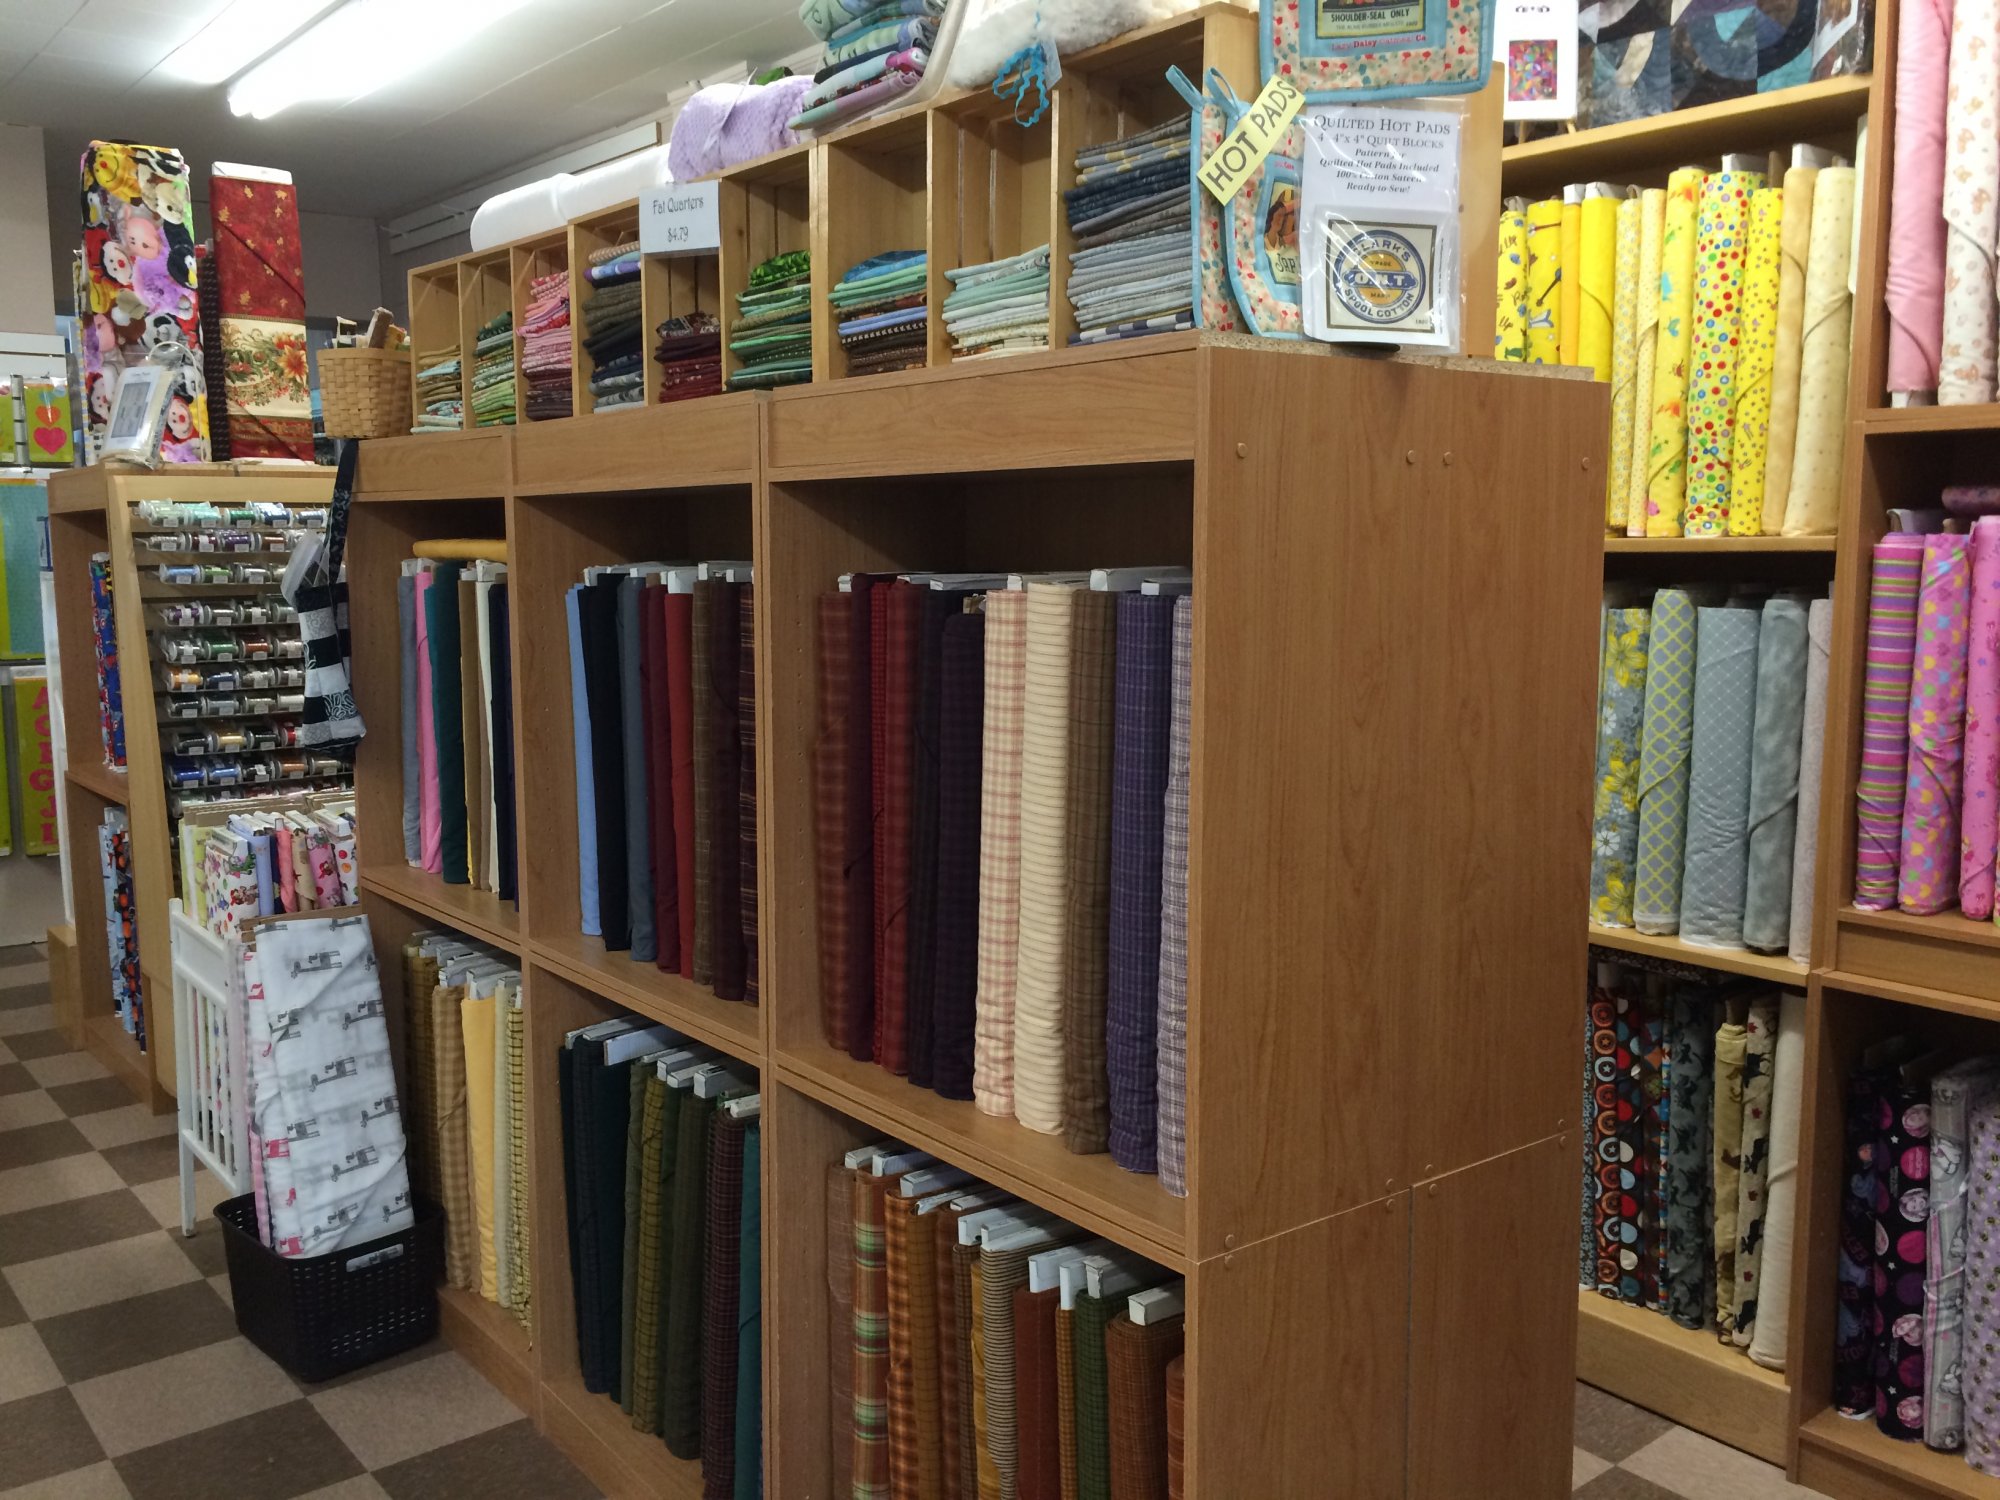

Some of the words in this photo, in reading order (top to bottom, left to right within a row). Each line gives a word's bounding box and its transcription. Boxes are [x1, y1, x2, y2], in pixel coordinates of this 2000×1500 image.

[1331, 11, 1386, 22] SHOULDER-SEAL
[1390, 8, 1410, 18] ONLY
[1353, 39, 1377, 48] Daisy
[1314, 114, 1375, 131] QUILTED
[1380, 118, 1412, 132] HOT
[1416, 120, 1450, 135] PADS
[1206, 130, 1258, 192] HOT
[1250, 80, 1297, 138] PADS
[1366, 135, 1400, 148] QUILT
[1402, 137, 1444, 149] BLOCKS
[1355, 148, 1390, 158] Pattern
[1375, 160, 1397, 170] Pads
[1399, 162, 1440, 172] Included
[1347, 182, 1376, 192] Ready
[653, 199, 666, 215] Fat
[667, 196, 704, 213] Quarters
[667, 225, 689, 243] $4.79
[1345, 288, 1374, 316] SPOOL
[1376, 293, 1415, 318] COTTON
